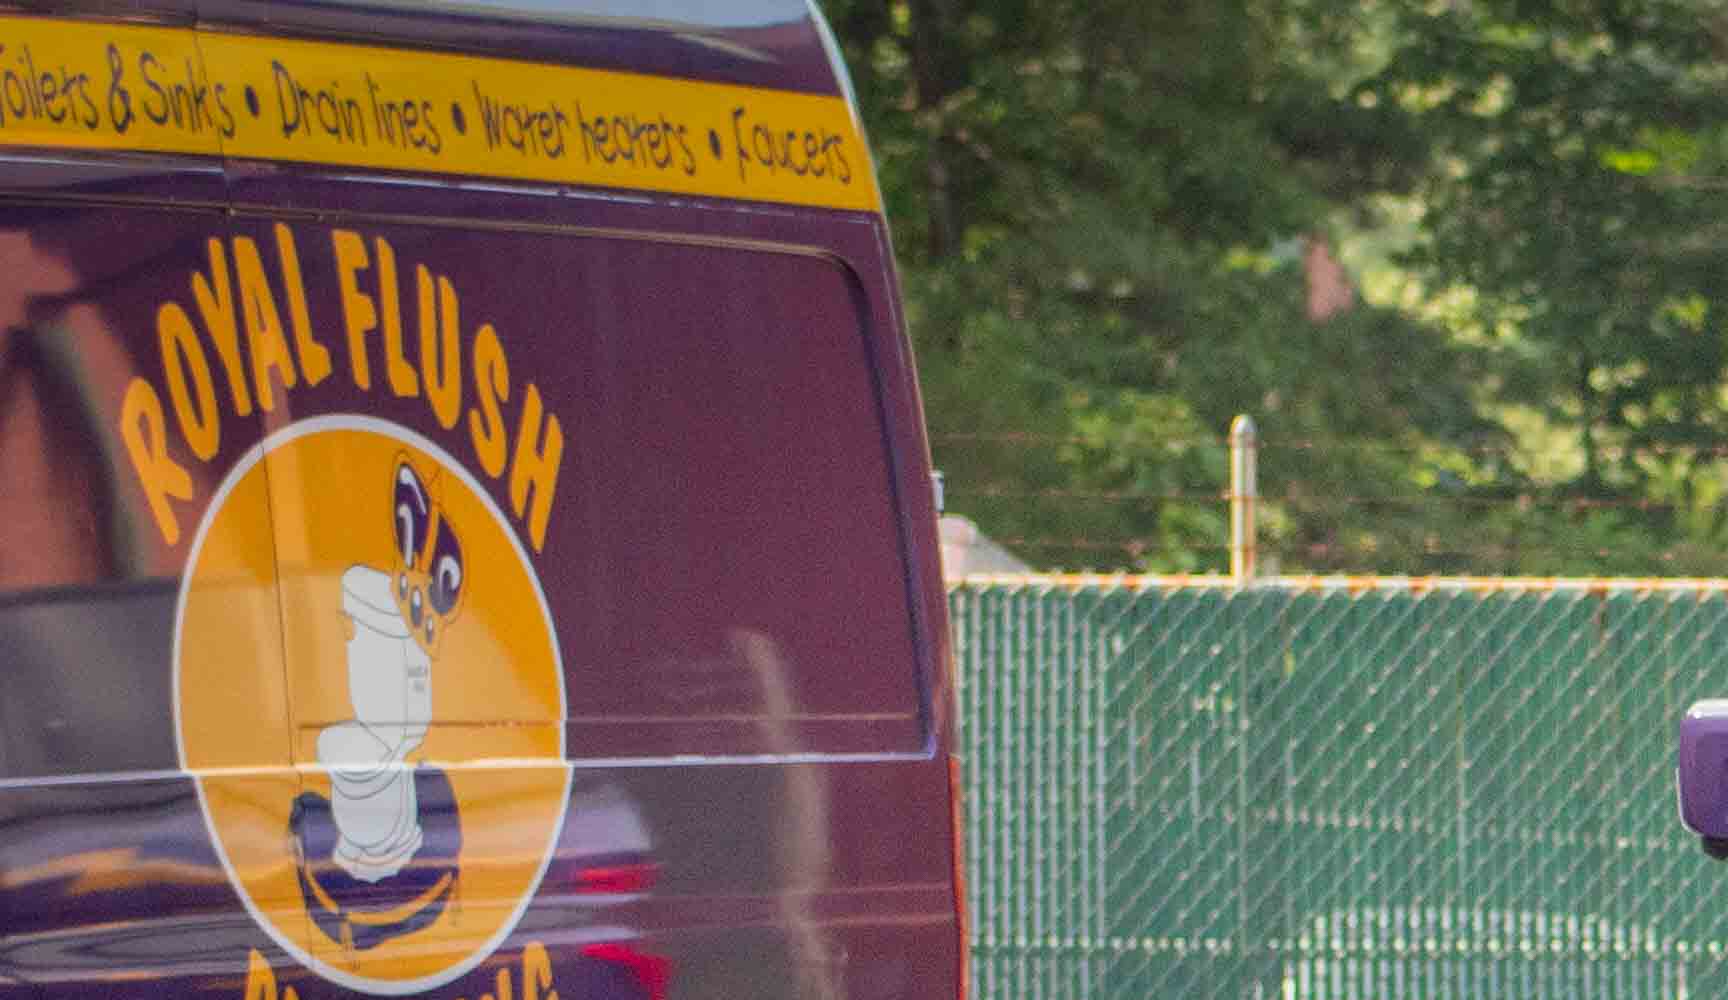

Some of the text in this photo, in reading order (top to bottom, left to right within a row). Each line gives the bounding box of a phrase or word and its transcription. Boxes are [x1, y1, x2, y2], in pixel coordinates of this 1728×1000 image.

[107, 43, 136, 134] &
[138, 51, 236, 139] Sinks
[271, 59, 368, 147] Drain
[365, 71, 441, 155] lines
[471, 79, 569, 160] Water
[576, 97, 698, 177] heaters
[731, 106, 852, 185] Faucets
[121, 222, 565, 554] ROYAL FLUSH
